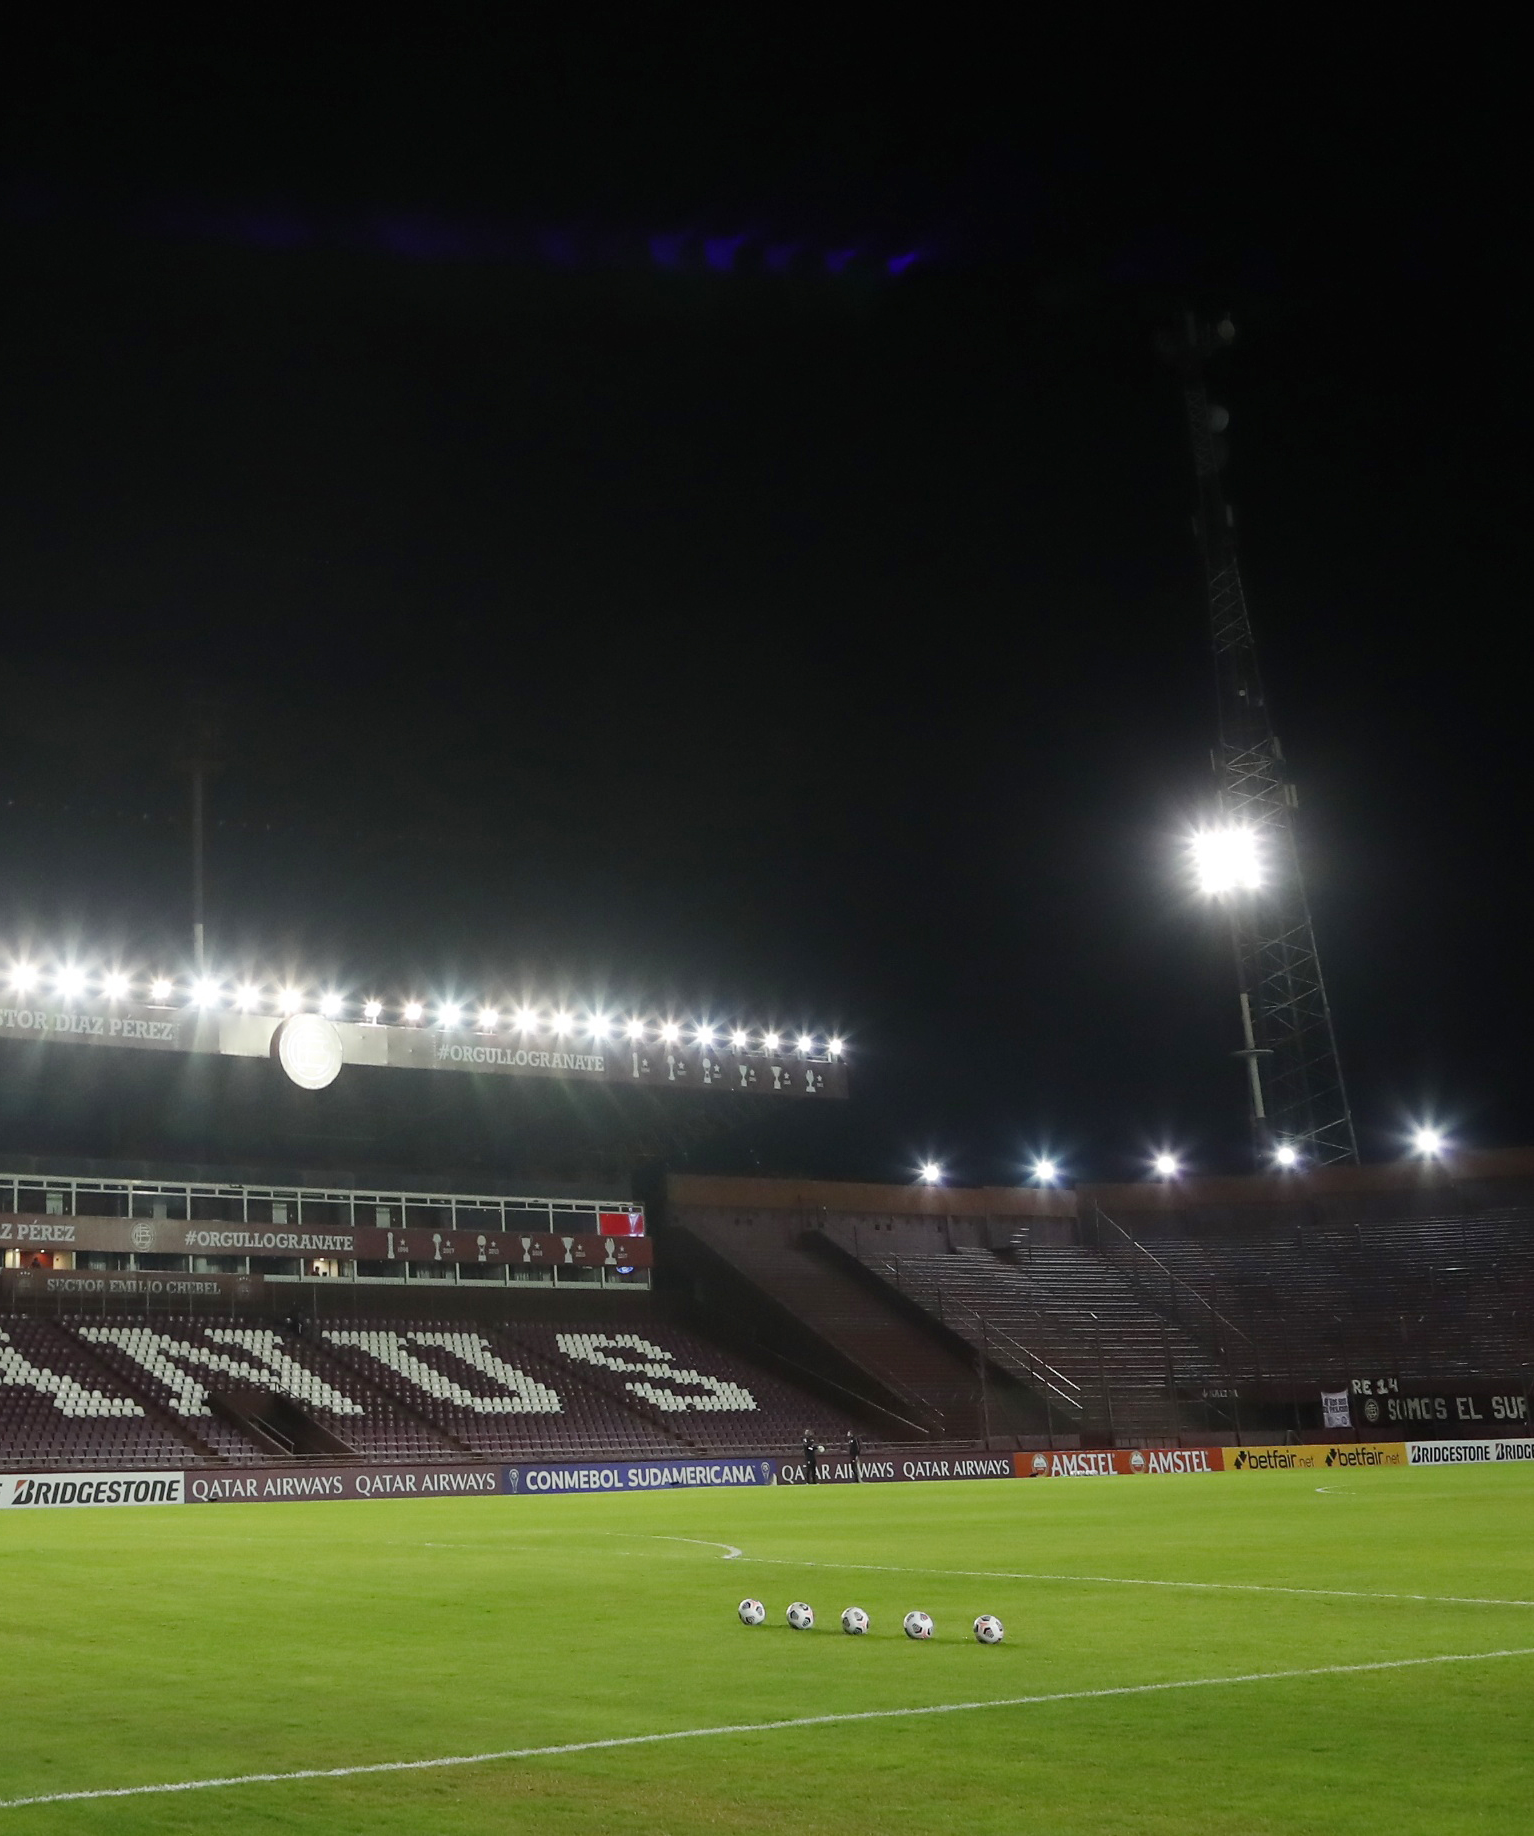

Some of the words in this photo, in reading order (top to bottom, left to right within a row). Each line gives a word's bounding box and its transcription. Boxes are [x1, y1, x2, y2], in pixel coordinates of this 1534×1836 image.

[53, 1012, 104, 1036] DÍAZ
[109, 1014, 174, 1041] PÉREZ
[438, 1043, 605, 1072] #ORGULLOGRANATE
[17, 1220, 75, 1242] PÉREZ
[184, 1230, 354, 1251] #ORGULLOGRANATE
[46, 1278, 106, 1293] SECTOR
[109, 1280, 164, 1294] EMILIO
[166, 1282, 222, 1296] CHEBEL
[1456, 1397, 1483, 1420] EL
[1051, 1452, 1118, 1477] AMSTEL
[1148, 1449, 1212, 1473] AMSTEL
[1248, 1449, 1315, 1470] betfair.net
[1338, 1446, 1400, 1467] betfair.net
[1411, 1445, 1491, 1464] BRIDGESTONE
[526, 1469, 624, 1491] CONMEBOL
[628, 1465, 756, 1487] SUDAMERICANA
[781, 1463, 832, 1484] QAAR
[903, 1461, 951, 1481] QATAR
[953, 1459, 1010, 1476] AIRWAYS
[12, 1479, 181, 1506] BRIDGESTONE
[192, 1478, 259, 1502] QATAR
[263, 1475, 343, 1497] AIRWAYS
[355, 1474, 417, 1497] QATAR
[421, 1472, 496, 1492] AIRWAYS
